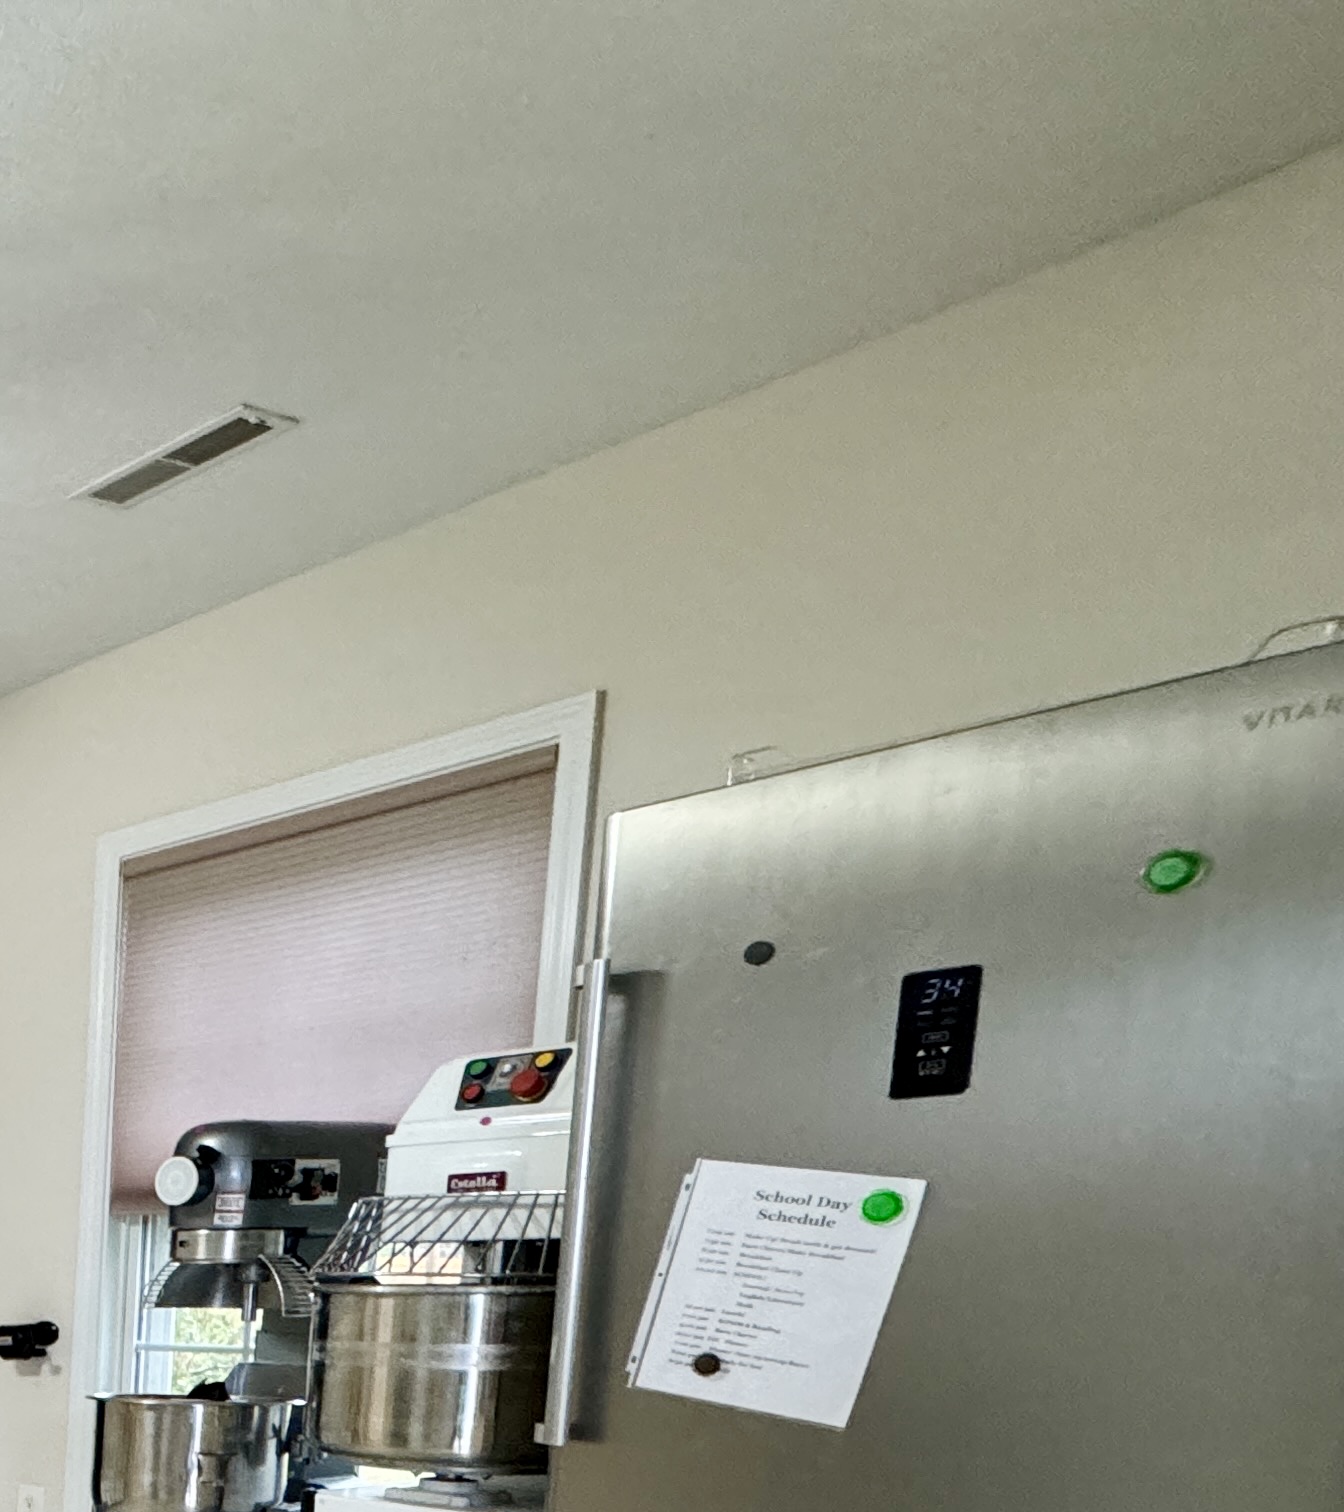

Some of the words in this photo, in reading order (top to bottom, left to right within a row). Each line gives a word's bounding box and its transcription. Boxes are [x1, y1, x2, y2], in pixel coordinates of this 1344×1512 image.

[920, 978, 964, 1004] 34
[753, 1189, 813, 1207] School
[817, 1196, 853, 1213] Day
[756, 1208, 837, 1229] Schedule
